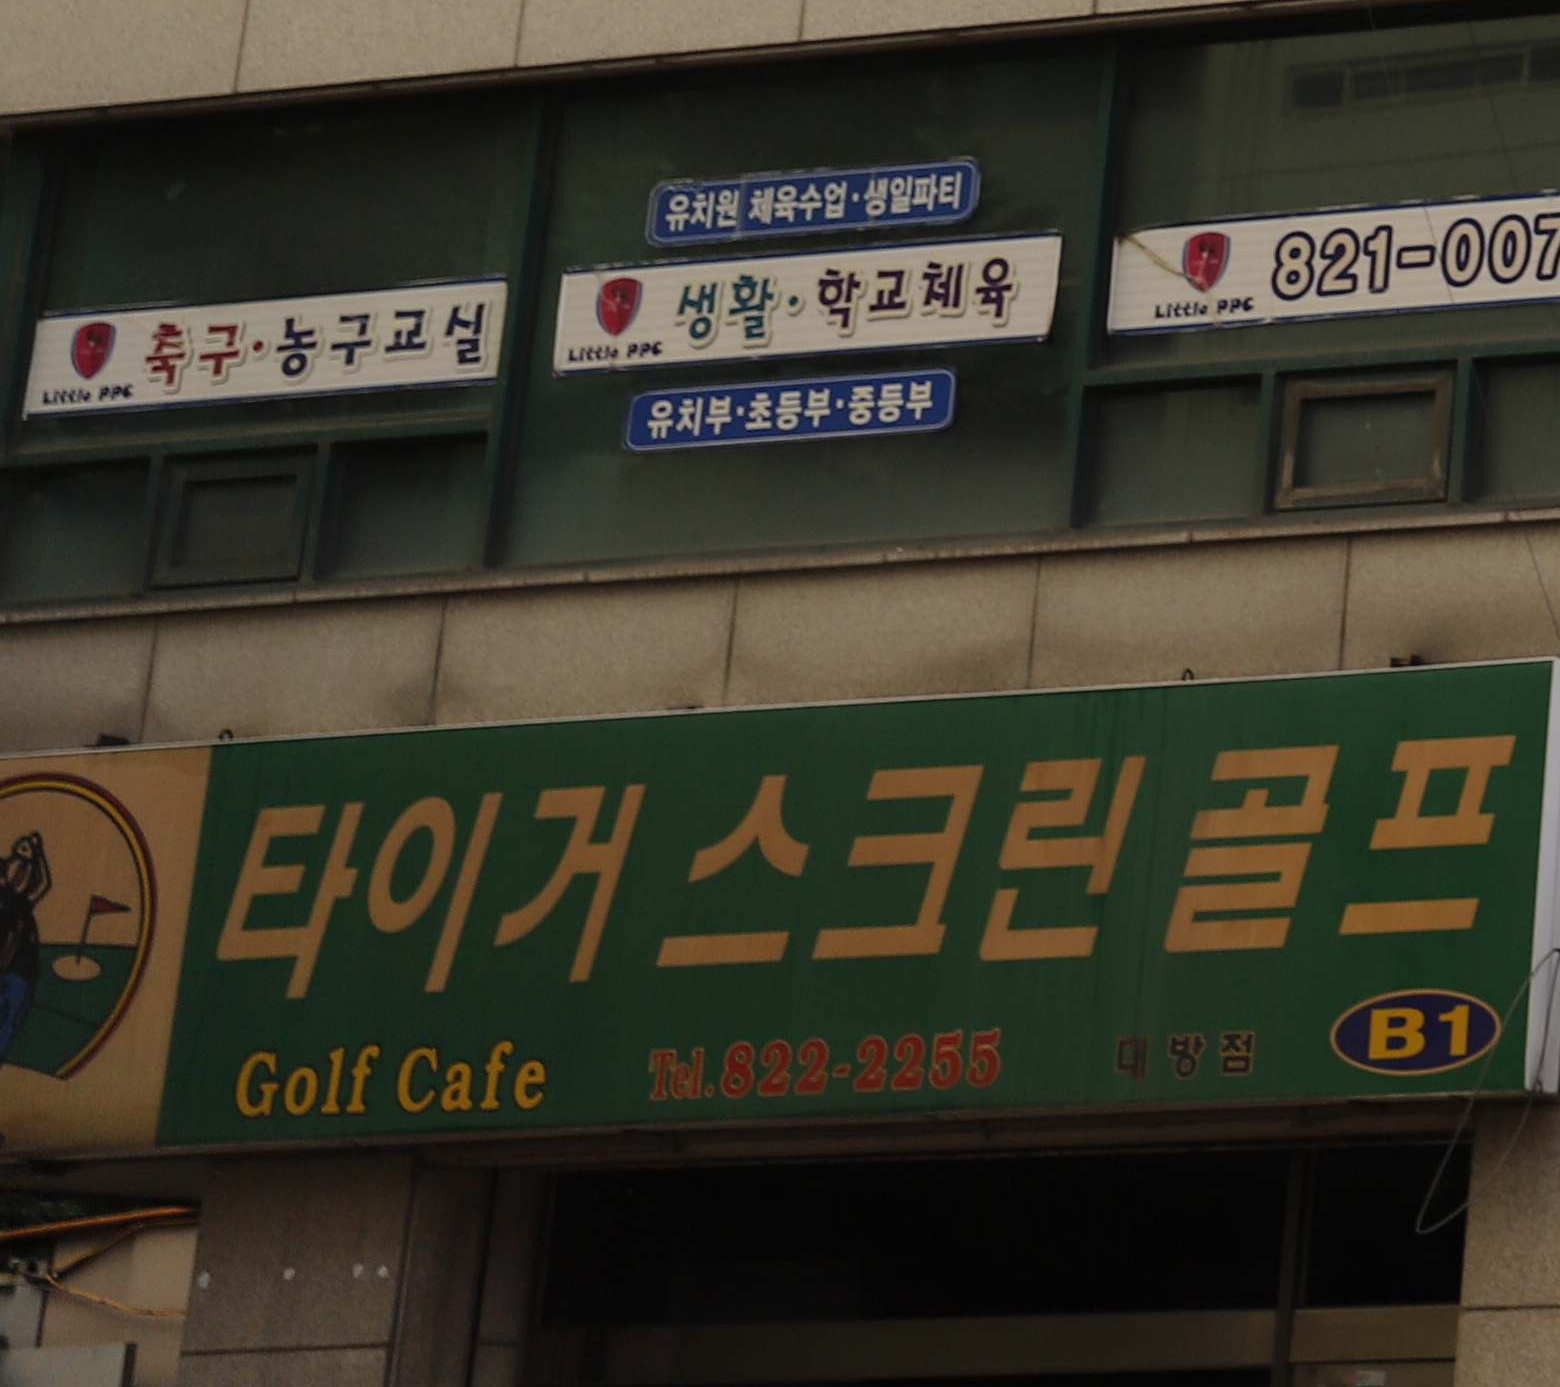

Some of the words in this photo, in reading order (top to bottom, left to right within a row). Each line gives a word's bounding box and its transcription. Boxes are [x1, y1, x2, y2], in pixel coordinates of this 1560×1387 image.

[665, 189, 741, 232] 유치원
[1154, 300, 1208, 319] Little
[216, 783, 646, 1000] 타이거
[655, 755, 1147, 968] 스크린
[1163, 734, 1518, 954] 골프
[1115, 1031, 1256, 1080] 대방점
[1366, 1004, 1470, 1060] B1
[235, 1041, 381, 1119] Golf
[398, 1038, 548, 1116] Cafe
